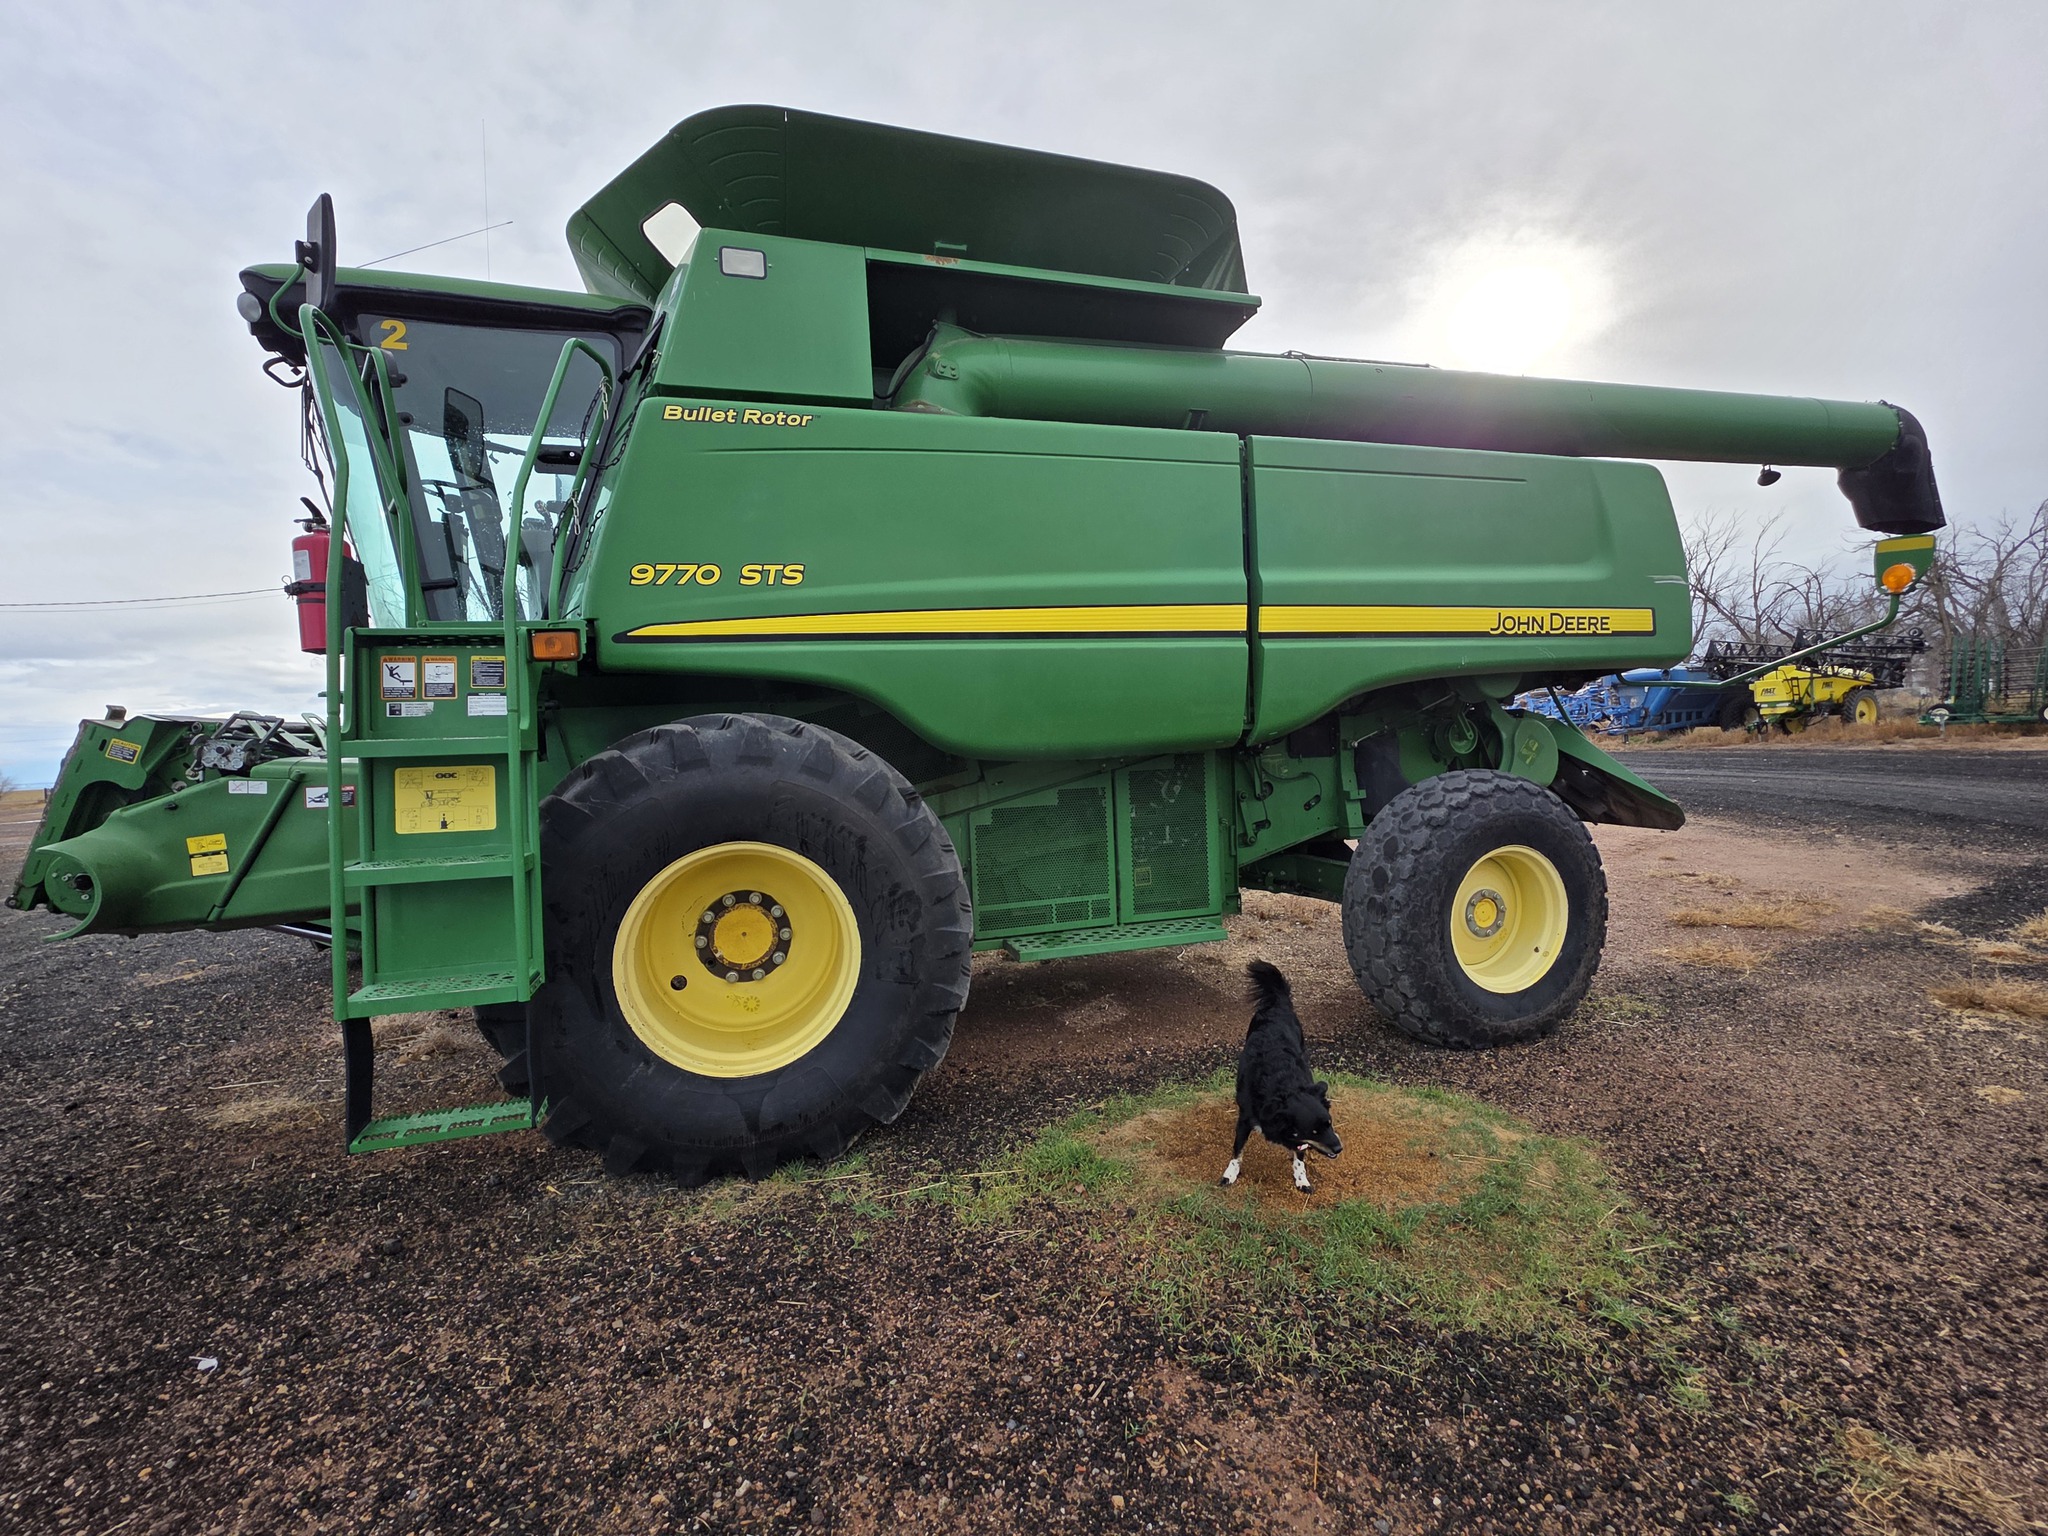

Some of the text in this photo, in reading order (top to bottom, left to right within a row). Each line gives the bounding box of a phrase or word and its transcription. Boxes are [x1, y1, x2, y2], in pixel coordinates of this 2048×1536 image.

[380, 319, 408, 350] 2
[663, 405, 738, 424] Bullet
[741, 409, 813, 427] Rotor
[630, 563, 806, 586] 9770 STS
[1490, 612, 1610, 632] JOHN DEERE
